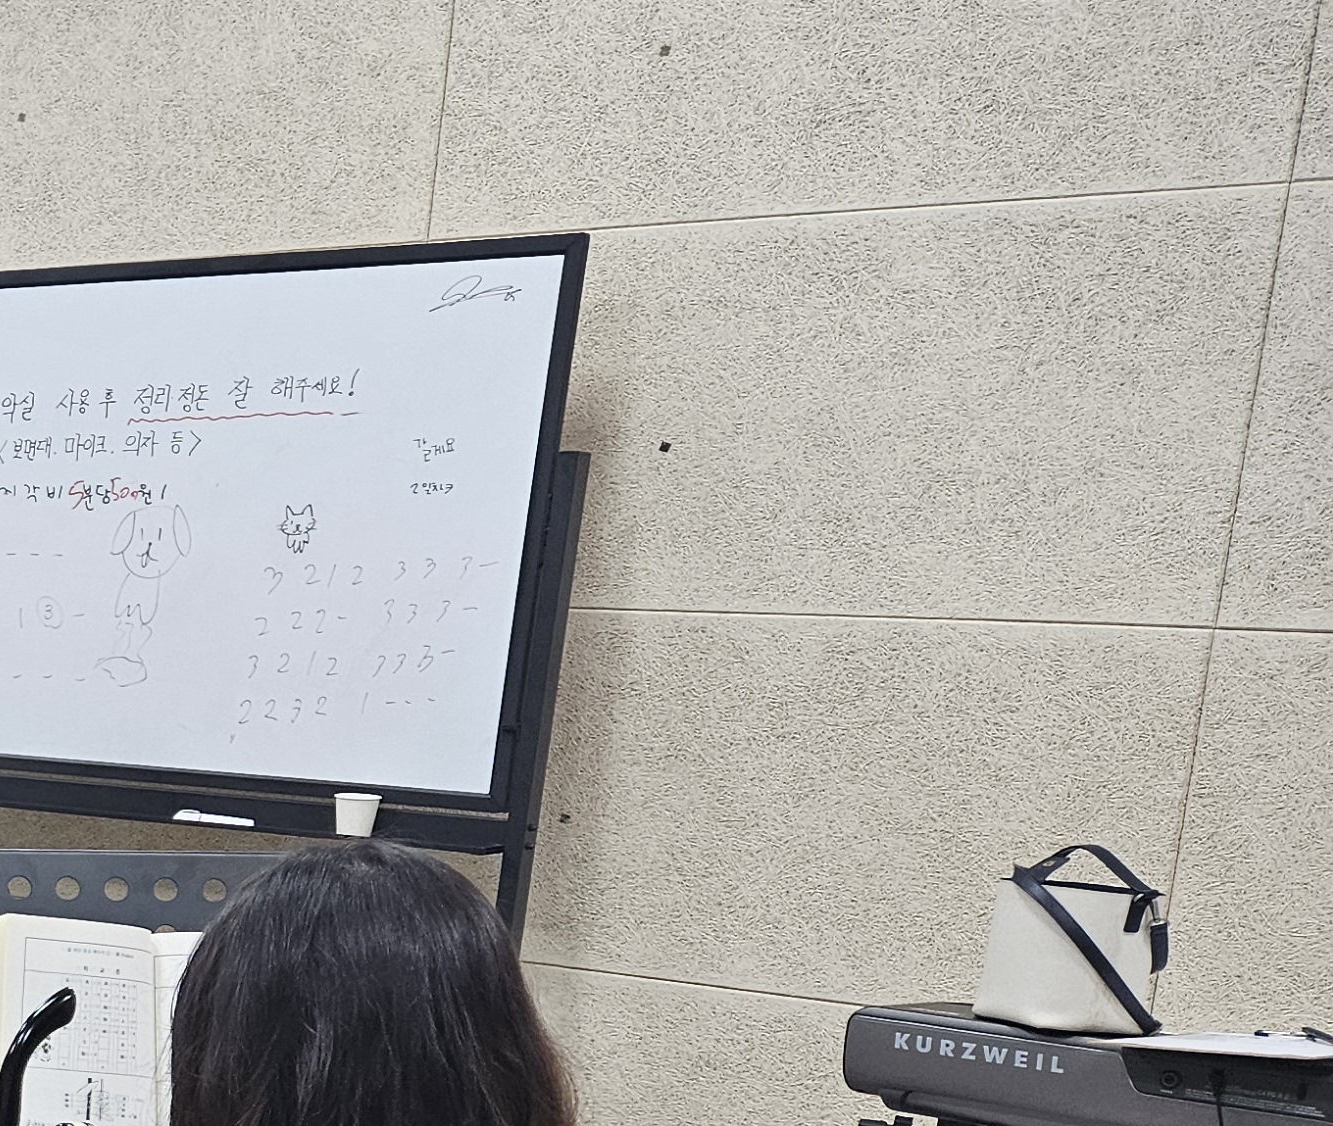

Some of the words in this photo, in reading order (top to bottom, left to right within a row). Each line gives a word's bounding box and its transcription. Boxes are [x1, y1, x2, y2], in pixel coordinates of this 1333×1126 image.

[55, 388, 90, 417] 사용
[99, 388, 117, 419] 후
[228, 376, 253, 409] 잘
[271, 368, 360, 403] 해주세요!
[122, 430, 159, 457] 의자
[893, 1031, 1065, 1075] KURZWEIL
